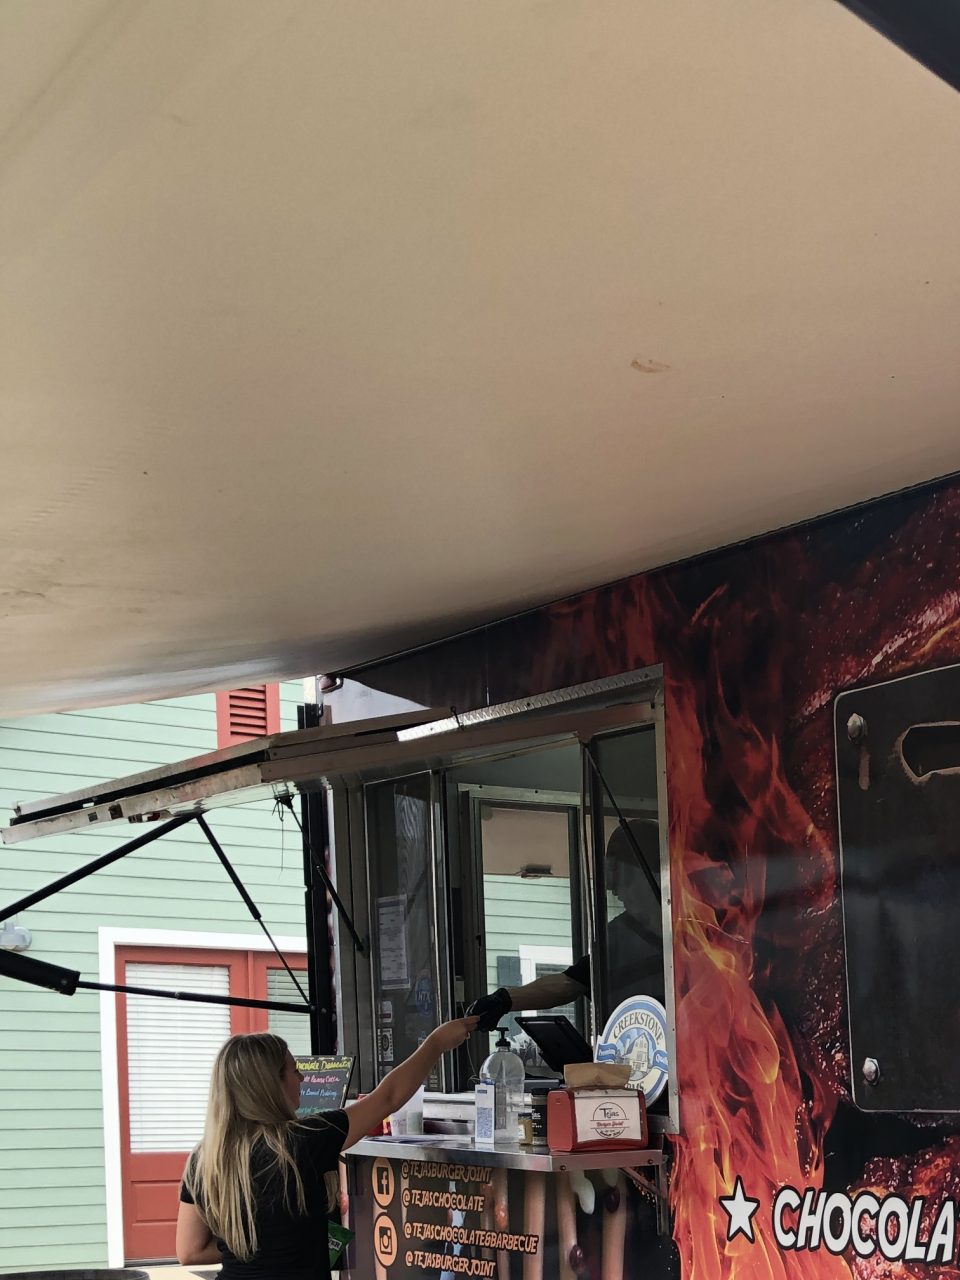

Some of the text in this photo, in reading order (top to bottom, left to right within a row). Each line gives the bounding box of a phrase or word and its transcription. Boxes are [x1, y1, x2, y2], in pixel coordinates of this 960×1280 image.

[613, 1012, 663, 1045] CREEKSTONE
[599, 1107, 620, 1119] Tejas
[402, 1189, 485, 1212] @TEJASCHOCOLATE
[404, 1222, 538, 1253] @TEJASCHOCOLATE&BARBECUE
[405, 1251, 496, 1277] @TEJASBURGERJOINT
